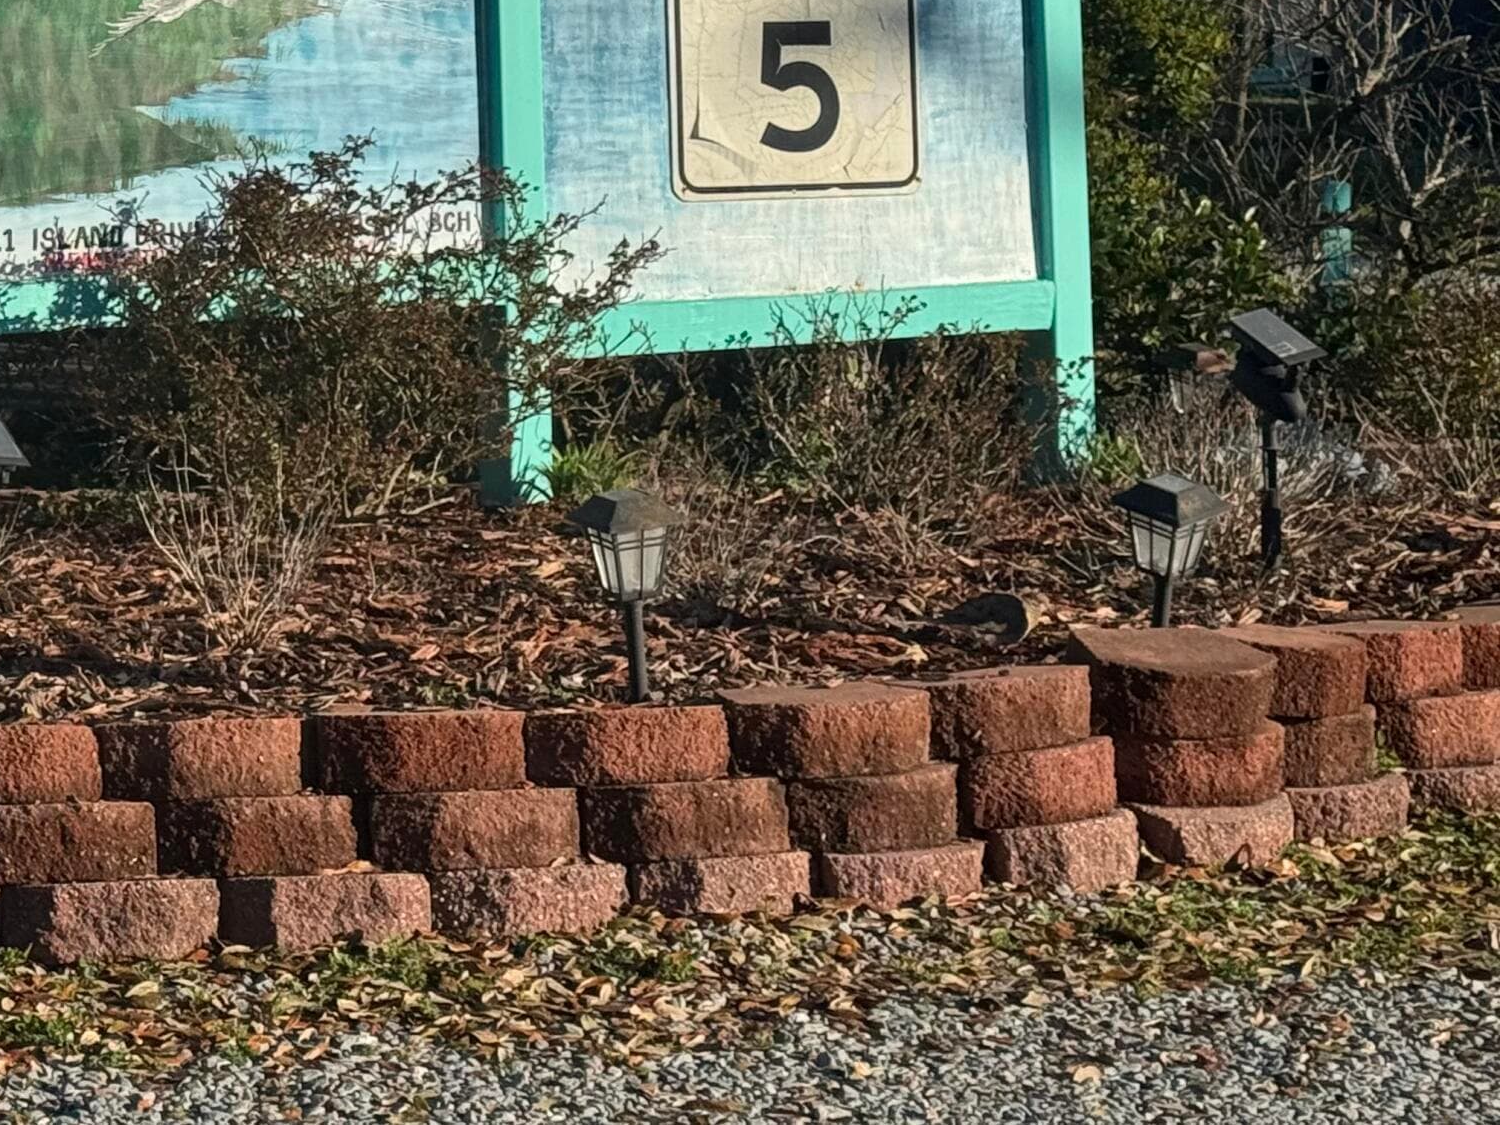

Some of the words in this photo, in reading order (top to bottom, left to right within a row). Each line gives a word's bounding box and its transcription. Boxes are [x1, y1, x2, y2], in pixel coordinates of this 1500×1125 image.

[760, 21, 841, 152] 5
[32, 225, 127, 251] ISLAND
[135, 219, 209, 247] DRIV
[430, 211, 470, 232] BCH
